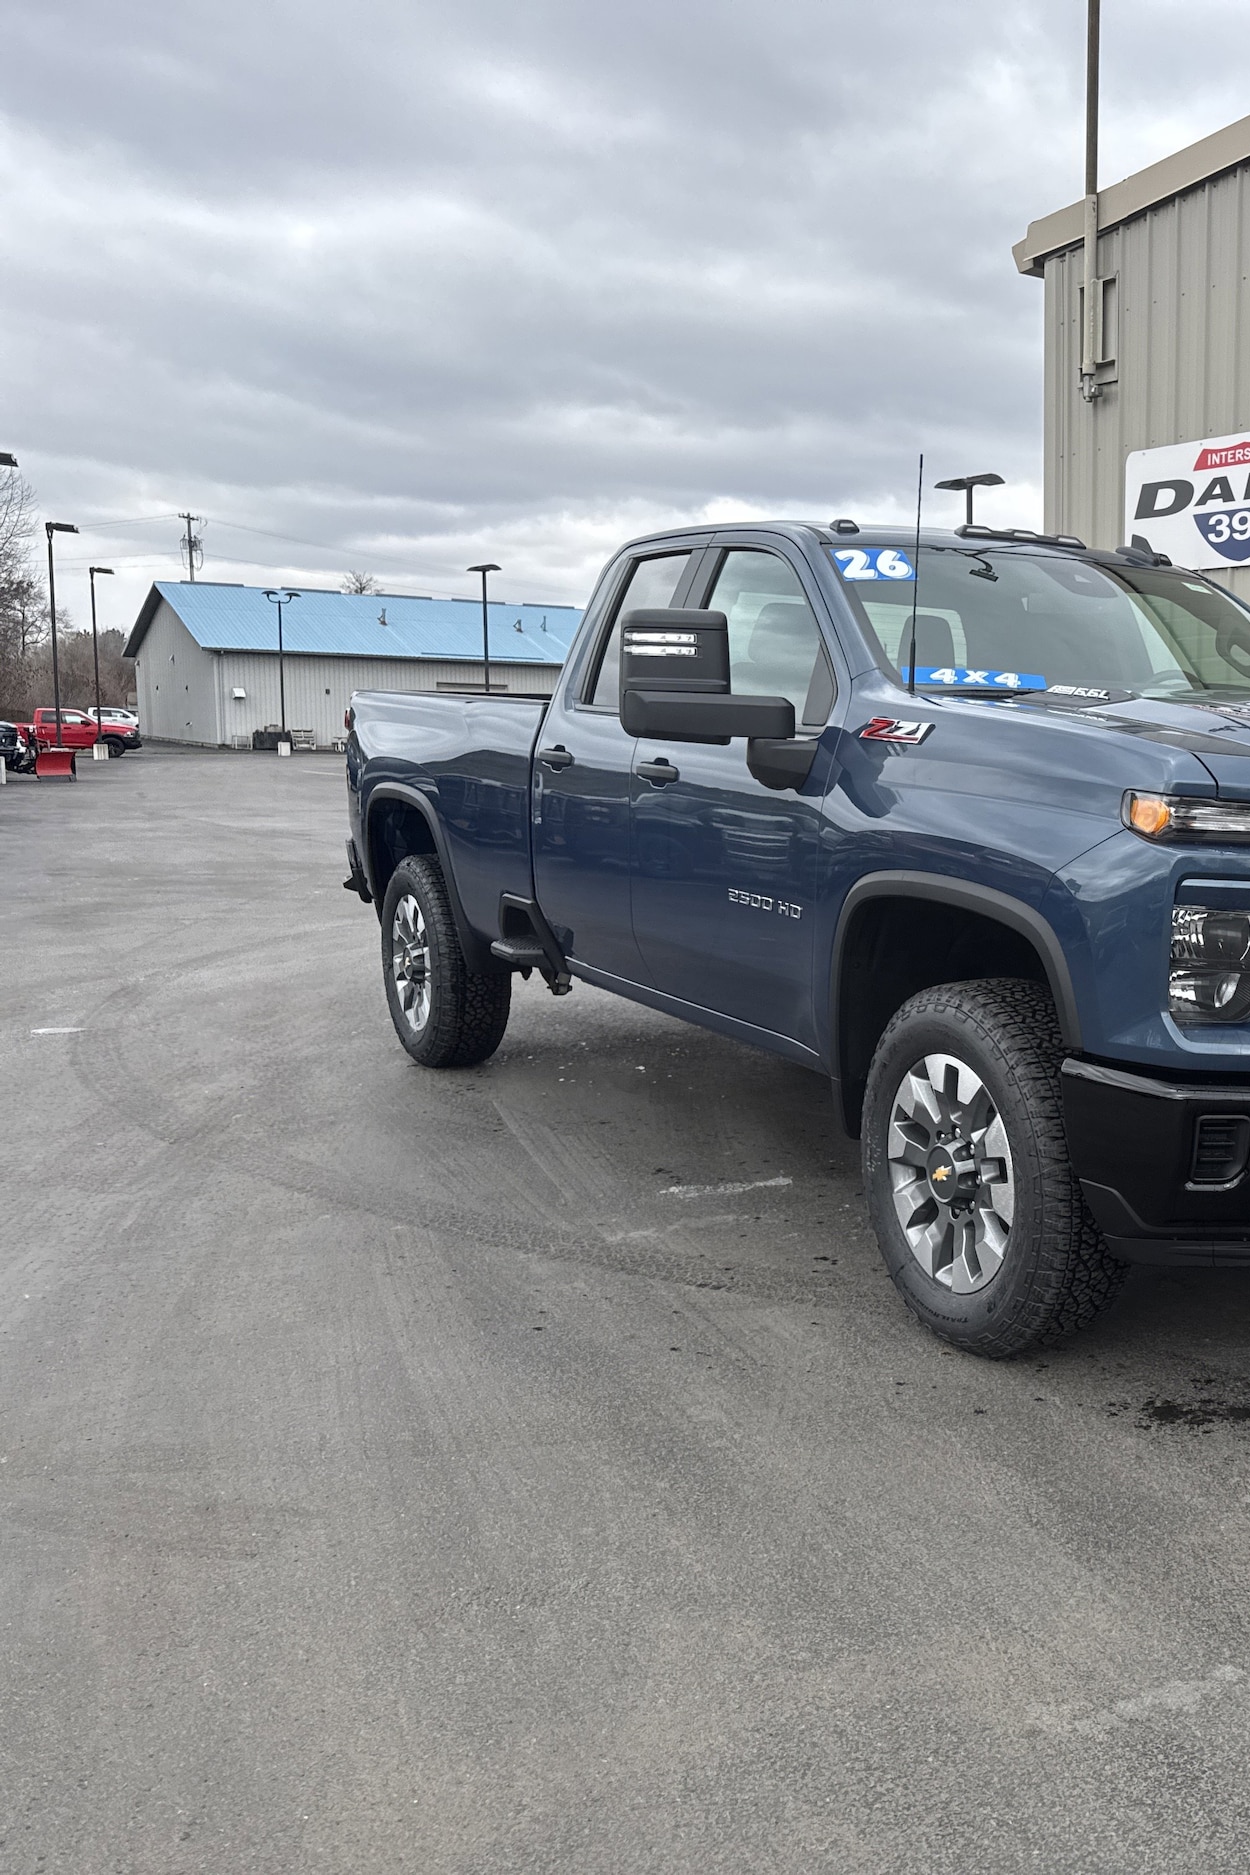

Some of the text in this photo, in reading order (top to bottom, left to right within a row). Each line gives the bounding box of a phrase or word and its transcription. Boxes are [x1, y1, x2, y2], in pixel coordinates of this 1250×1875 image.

[834, 549, 913, 580] 26
[859, 717, 935, 745] Z71
[728, 888, 803, 919] 2500 HD
